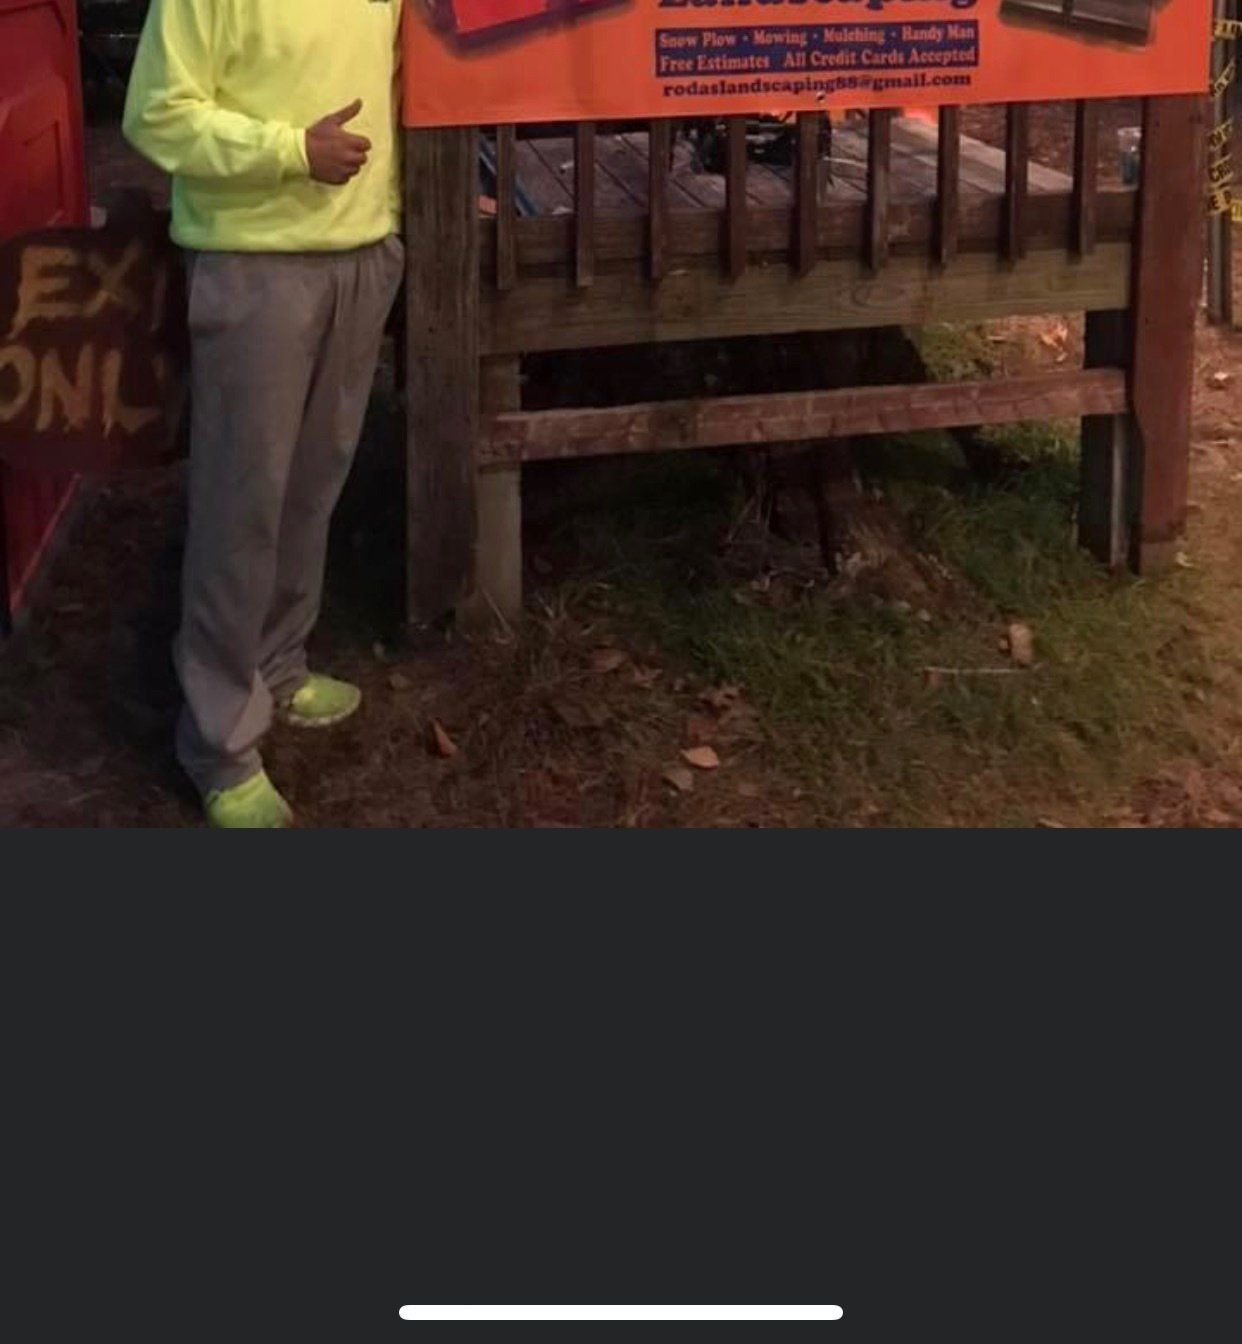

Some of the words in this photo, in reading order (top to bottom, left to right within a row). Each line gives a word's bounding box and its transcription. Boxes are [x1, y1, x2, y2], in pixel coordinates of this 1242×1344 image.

[659, 32, 697, 49] Snow
[703, 31, 737, 47] Plow
[754, 29, 809, 48] Mowing
[823, 26, 886, 46] Mulching
[901, 25, 944, 43] Handy
[947, 24, 975, 40] Man
[660, 56, 693, 72] Free
[697, 54, 771, 71] Estimates
[783, 50, 807, 68] All
[810, 50, 857, 66] Credit
[861, 48, 905, 65] Cards
[908, 45, 976, 65] Accepted
[662, 72, 972, 97] rodaslandscaping88@gmail.com
[10, 236, 168, 338] EXI
